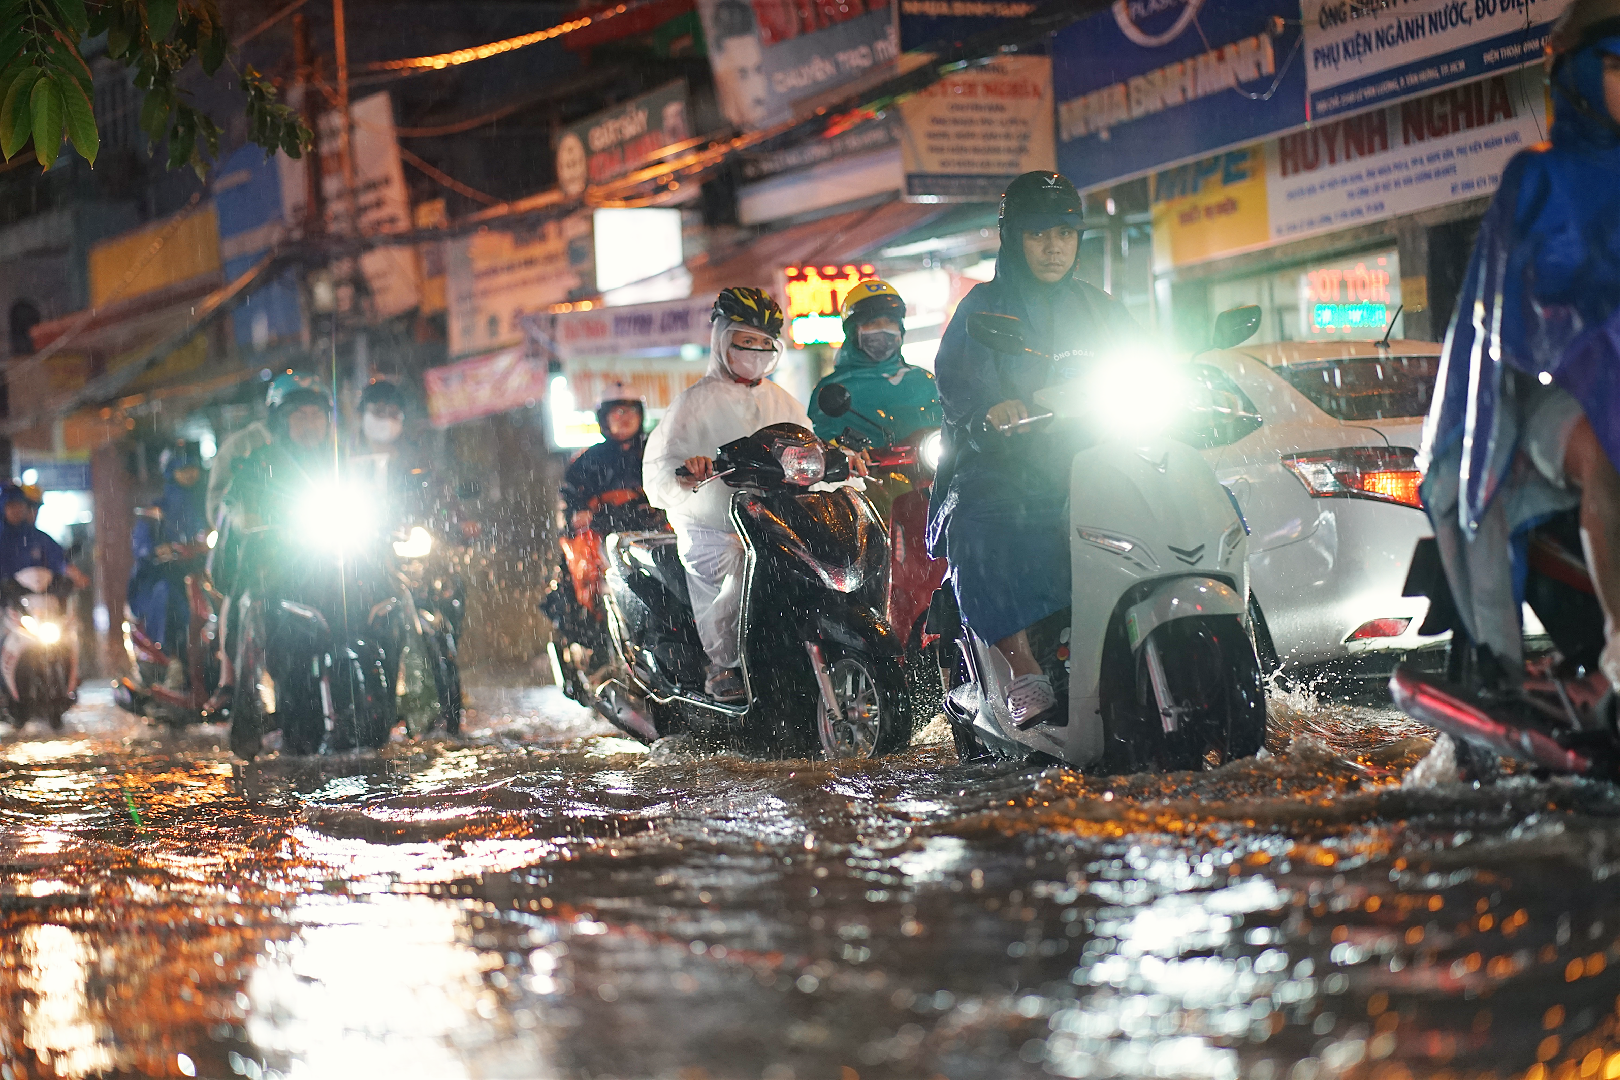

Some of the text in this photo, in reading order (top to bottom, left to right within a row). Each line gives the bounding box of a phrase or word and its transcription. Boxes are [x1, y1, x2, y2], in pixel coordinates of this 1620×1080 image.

[1313, 42, 1340, 71] PHỤ
[1342, 28, 1373, 64] KIỆN
[1374, 14, 1426, 52] NGÀNH
[1428, 1, 1472, 35] NƯỚC,
